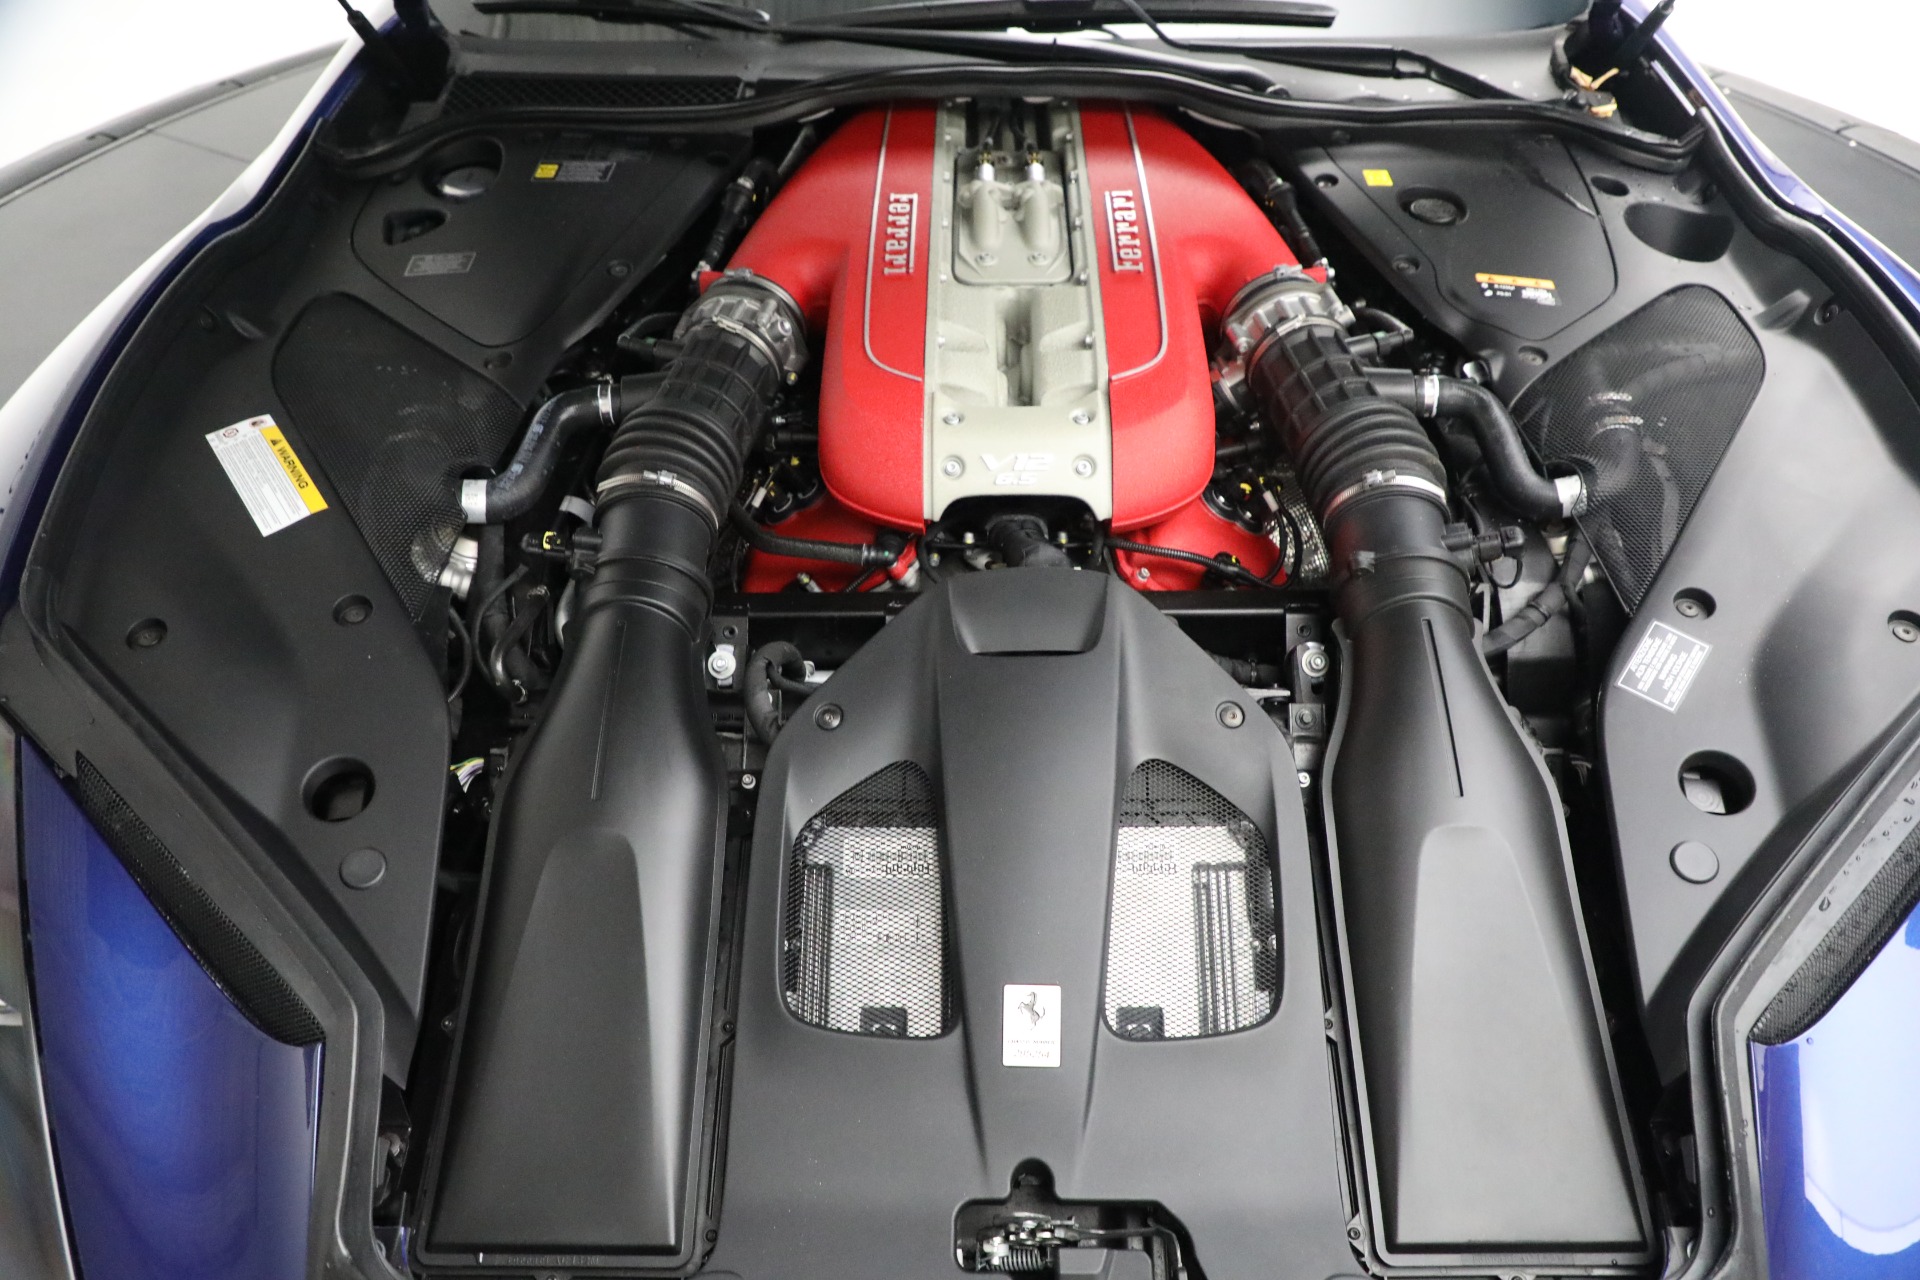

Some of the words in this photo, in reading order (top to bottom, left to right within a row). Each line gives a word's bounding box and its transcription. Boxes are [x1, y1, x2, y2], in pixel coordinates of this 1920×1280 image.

[883, 192, 918, 274] Ferrari
[1104, 190, 1144, 272] Ferrari
[277, 446, 309, 489] WARNING
[980, 453, 1053, 471] V12
[994, 472, 1038, 485] 6.5
